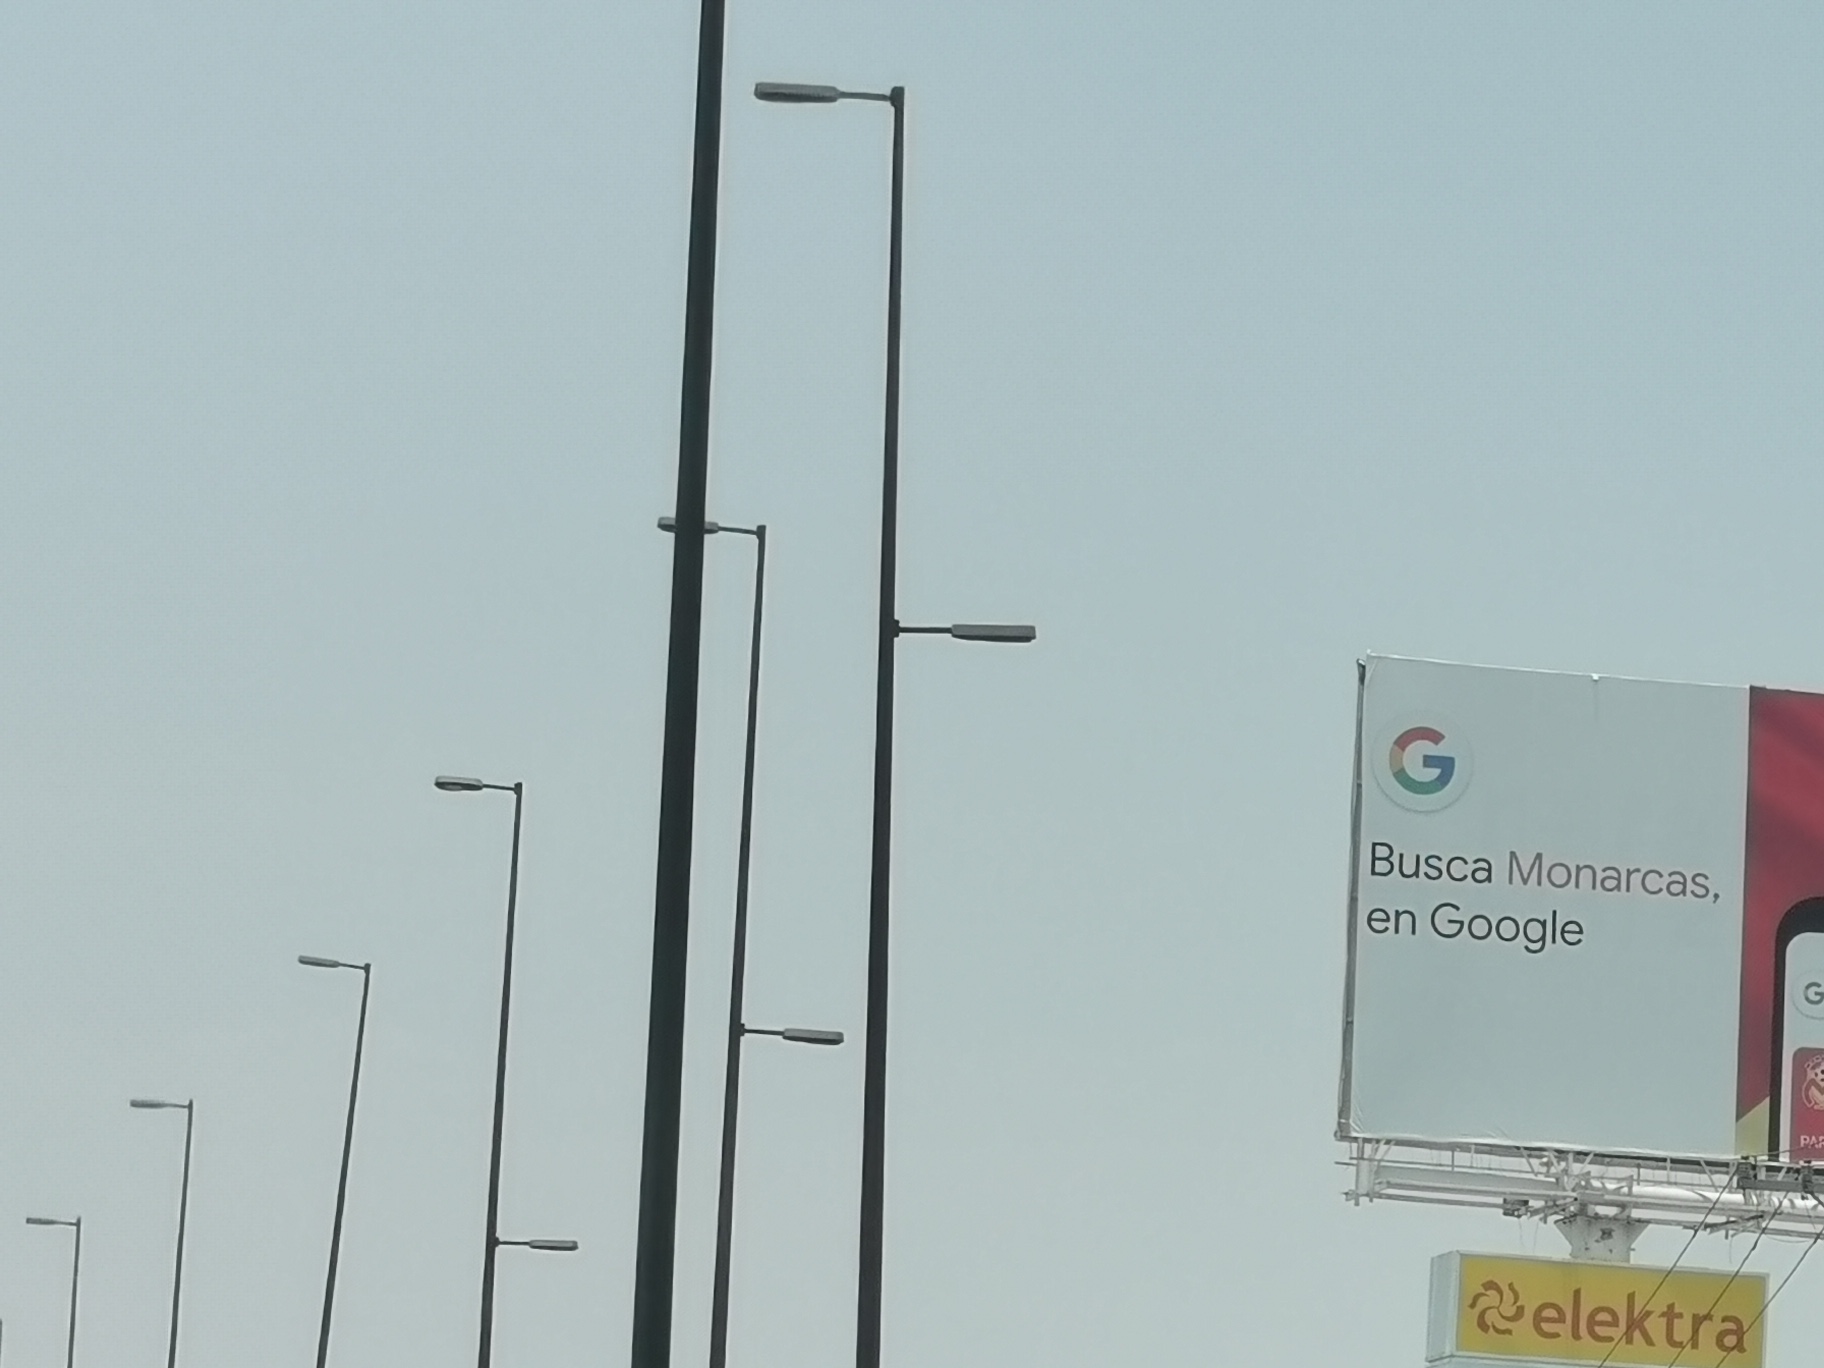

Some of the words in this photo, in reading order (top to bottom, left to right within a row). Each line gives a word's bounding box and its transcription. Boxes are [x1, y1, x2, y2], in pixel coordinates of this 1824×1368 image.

[1369, 841, 1493, 884] Busca
[1507, 850, 1720, 904] Monarcas,
[1366, 906, 1417, 935] en
[1430, 902, 1584, 954] Google
[1532, 1287, 1748, 1354] elektra
